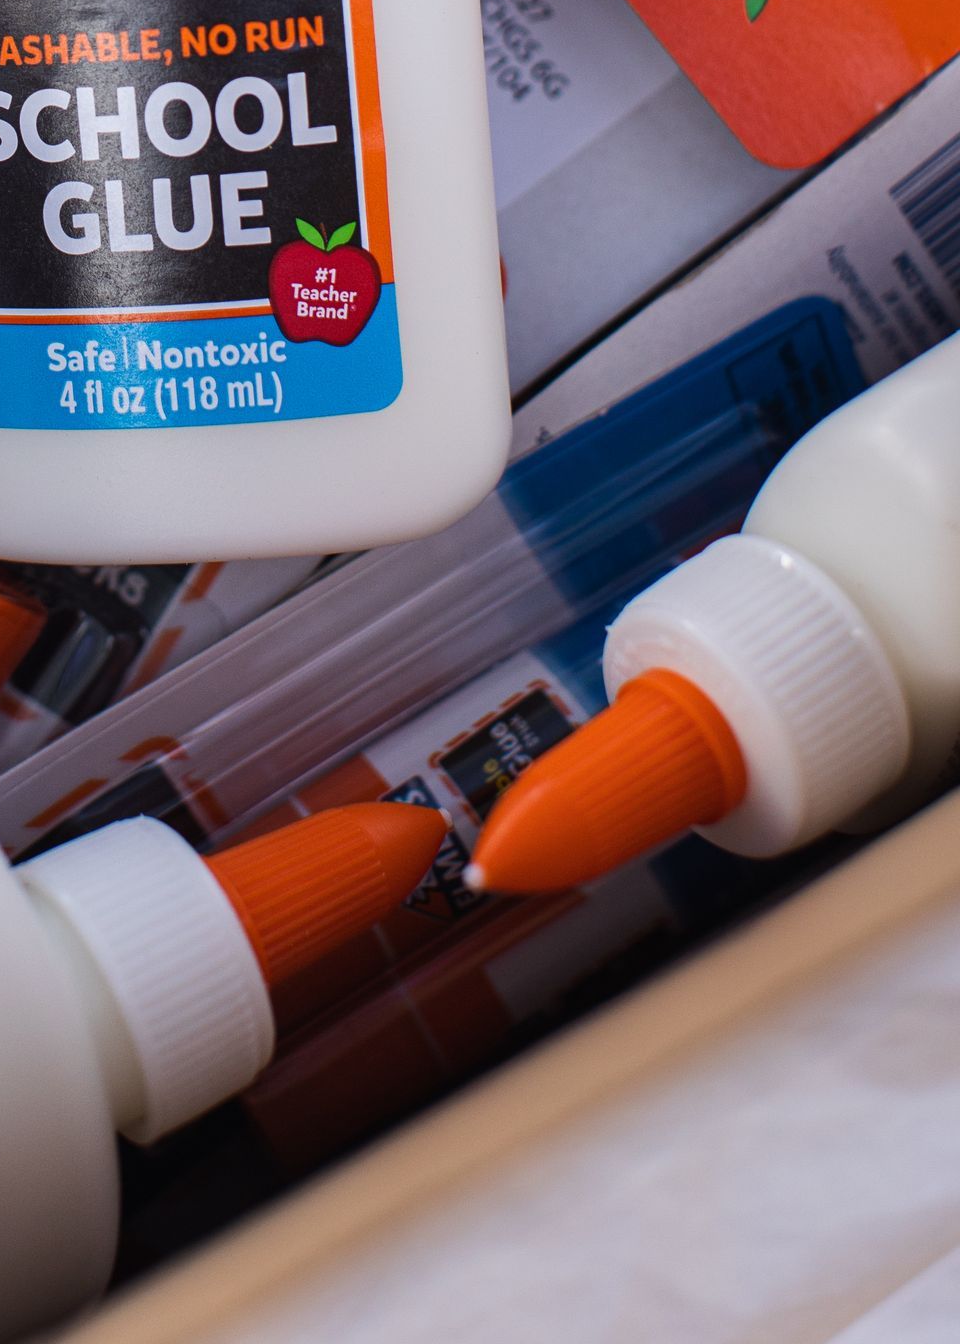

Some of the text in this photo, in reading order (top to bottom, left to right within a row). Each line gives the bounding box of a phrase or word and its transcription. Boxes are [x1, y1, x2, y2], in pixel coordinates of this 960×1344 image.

[181, 24, 237, 58] NO
[245, 16, 324, 51] RUN
[42, 170, 272, 255] GLUE
[291, 283, 357, 303] Teacher
[314, 267, 337, 284] #1
[296, 301, 349, 320] Brand
[47, 331, 287, 373] Safe Nontoxic
[59, 371, 283, 420] 4 fl oz (118 mL)
